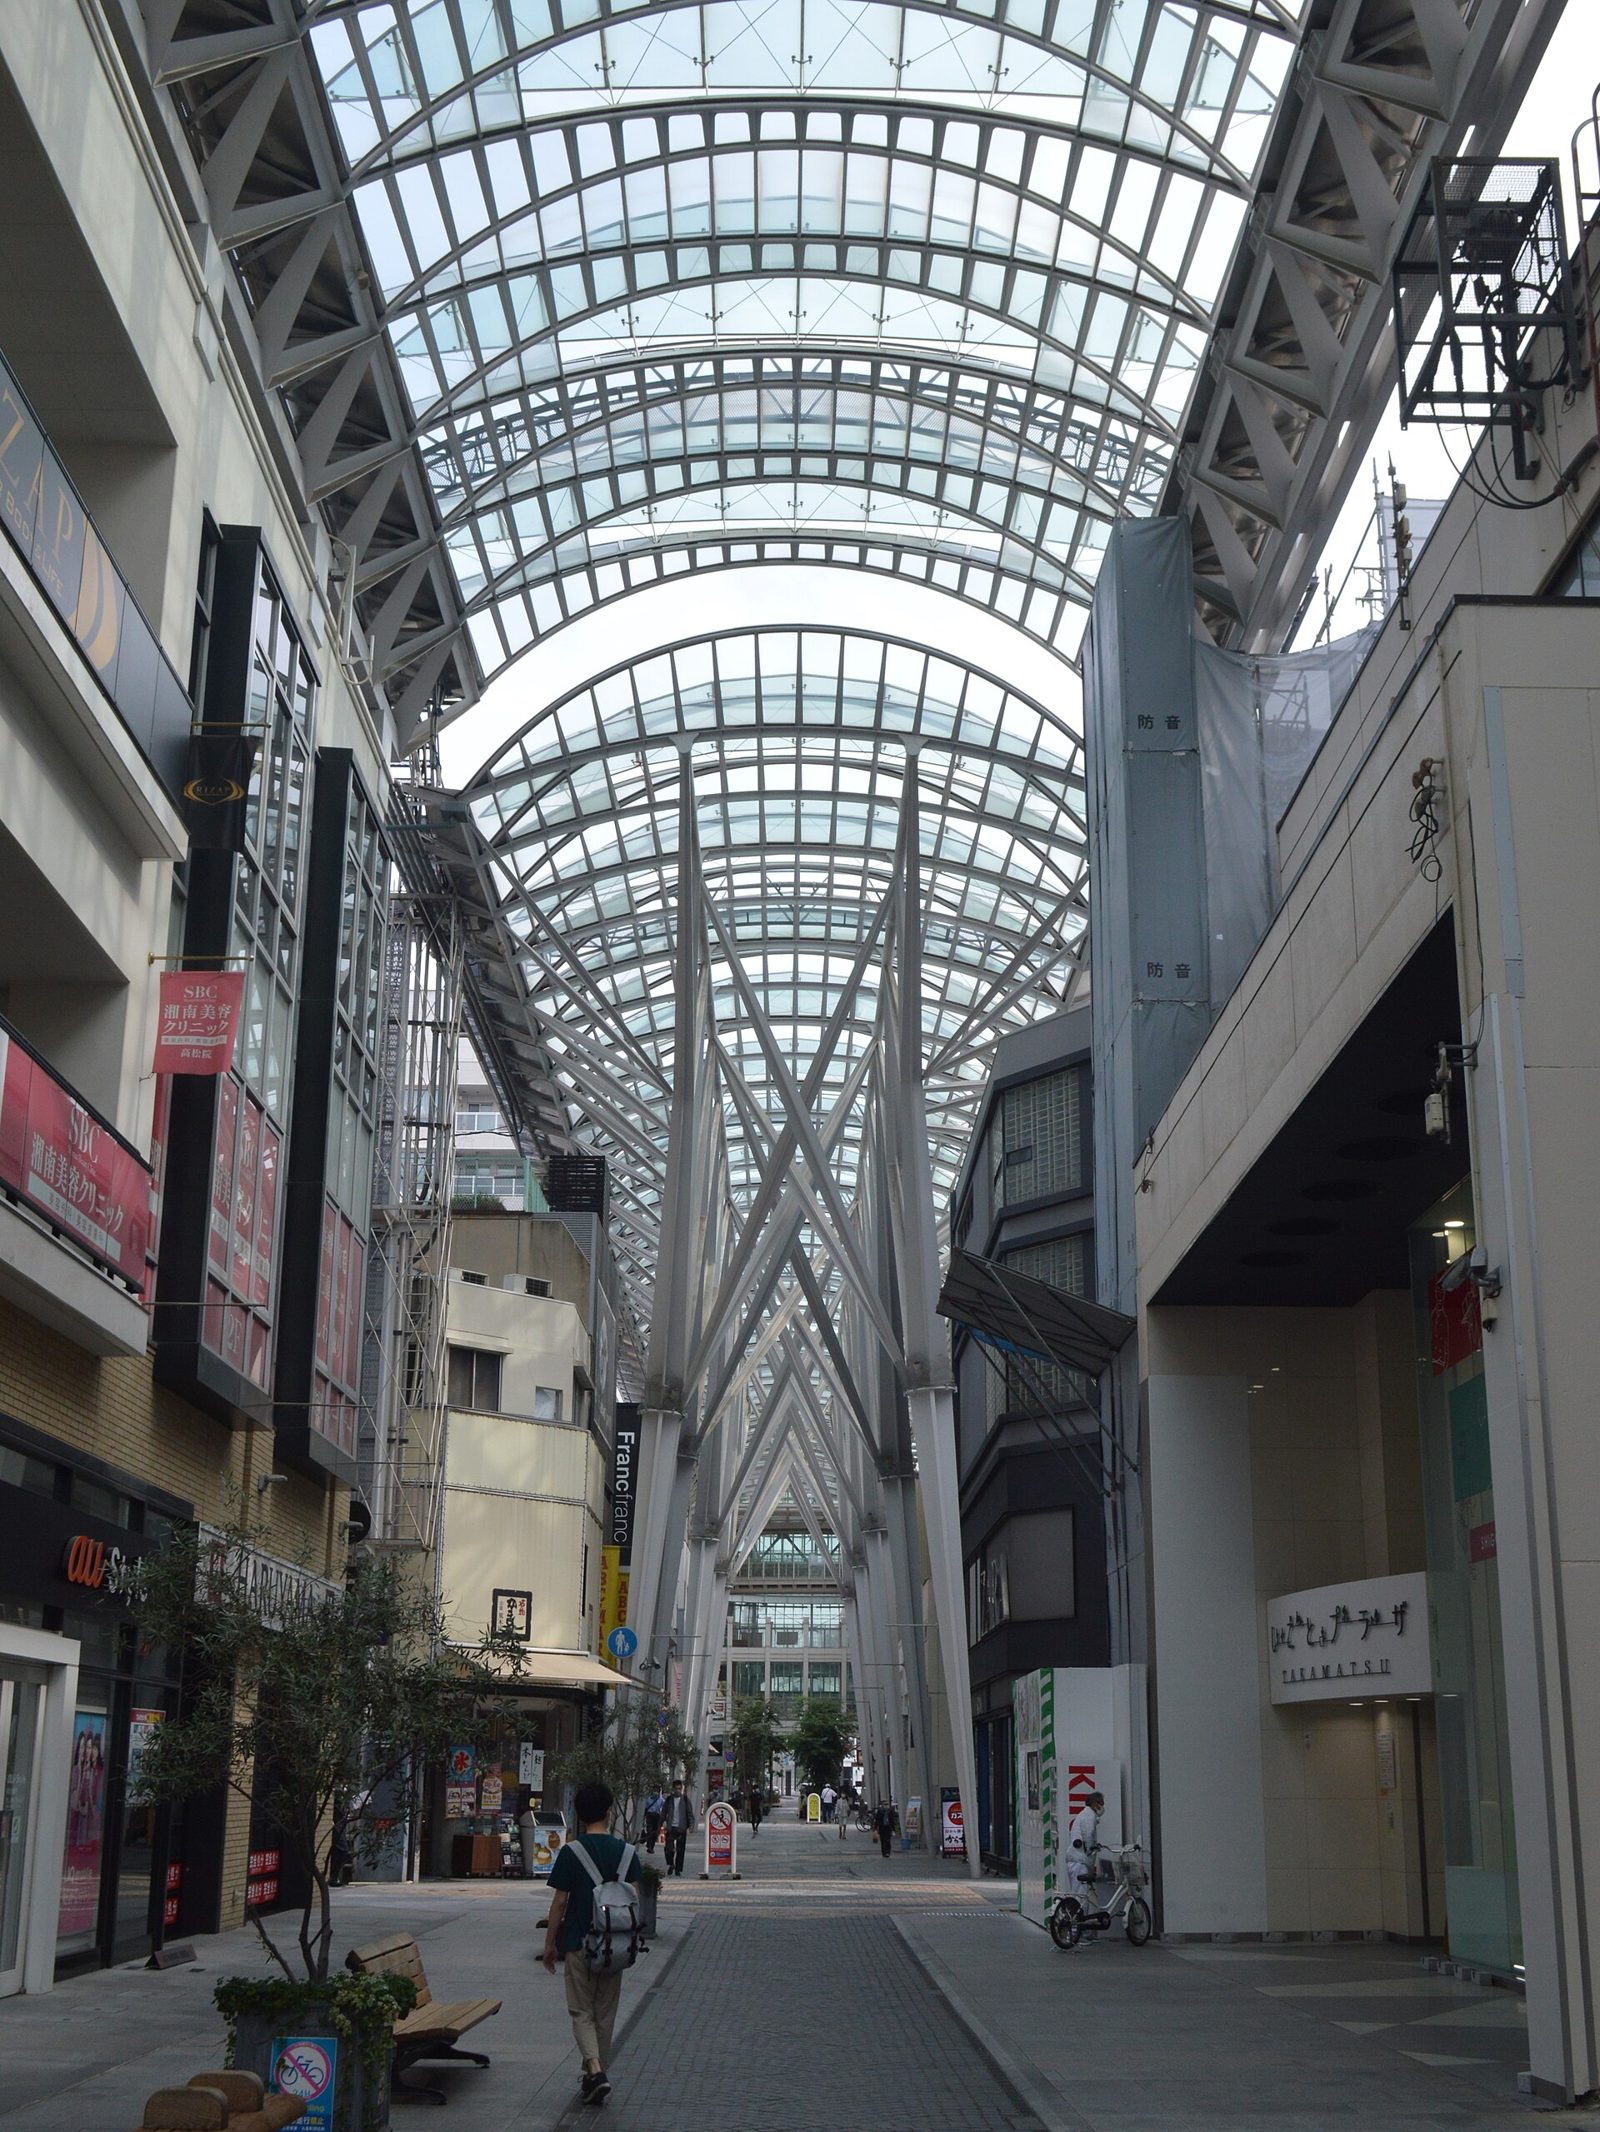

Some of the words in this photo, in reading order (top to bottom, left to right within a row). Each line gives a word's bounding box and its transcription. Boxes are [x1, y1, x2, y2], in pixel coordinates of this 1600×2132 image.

[1137, 714, 1181, 731] 防音
[1147, 962, 1191, 979] 防音
[183, 985, 218, 999] SBC
[163, 1003, 232, 1020] 湘南美容
[162, 1020, 230, 1036] クリニック
[180, 1048, 213, 1059] 高松院
[69, 1106, 100, 1164] SBC
[30, 1131, 124, 1233] 湘南美容クリニック
[613, 1430, 636, 1544] Francfranc
[67, 1534, 107, 1589] au
[1282, 1658, 1392, 1684] TAKAMATSU
